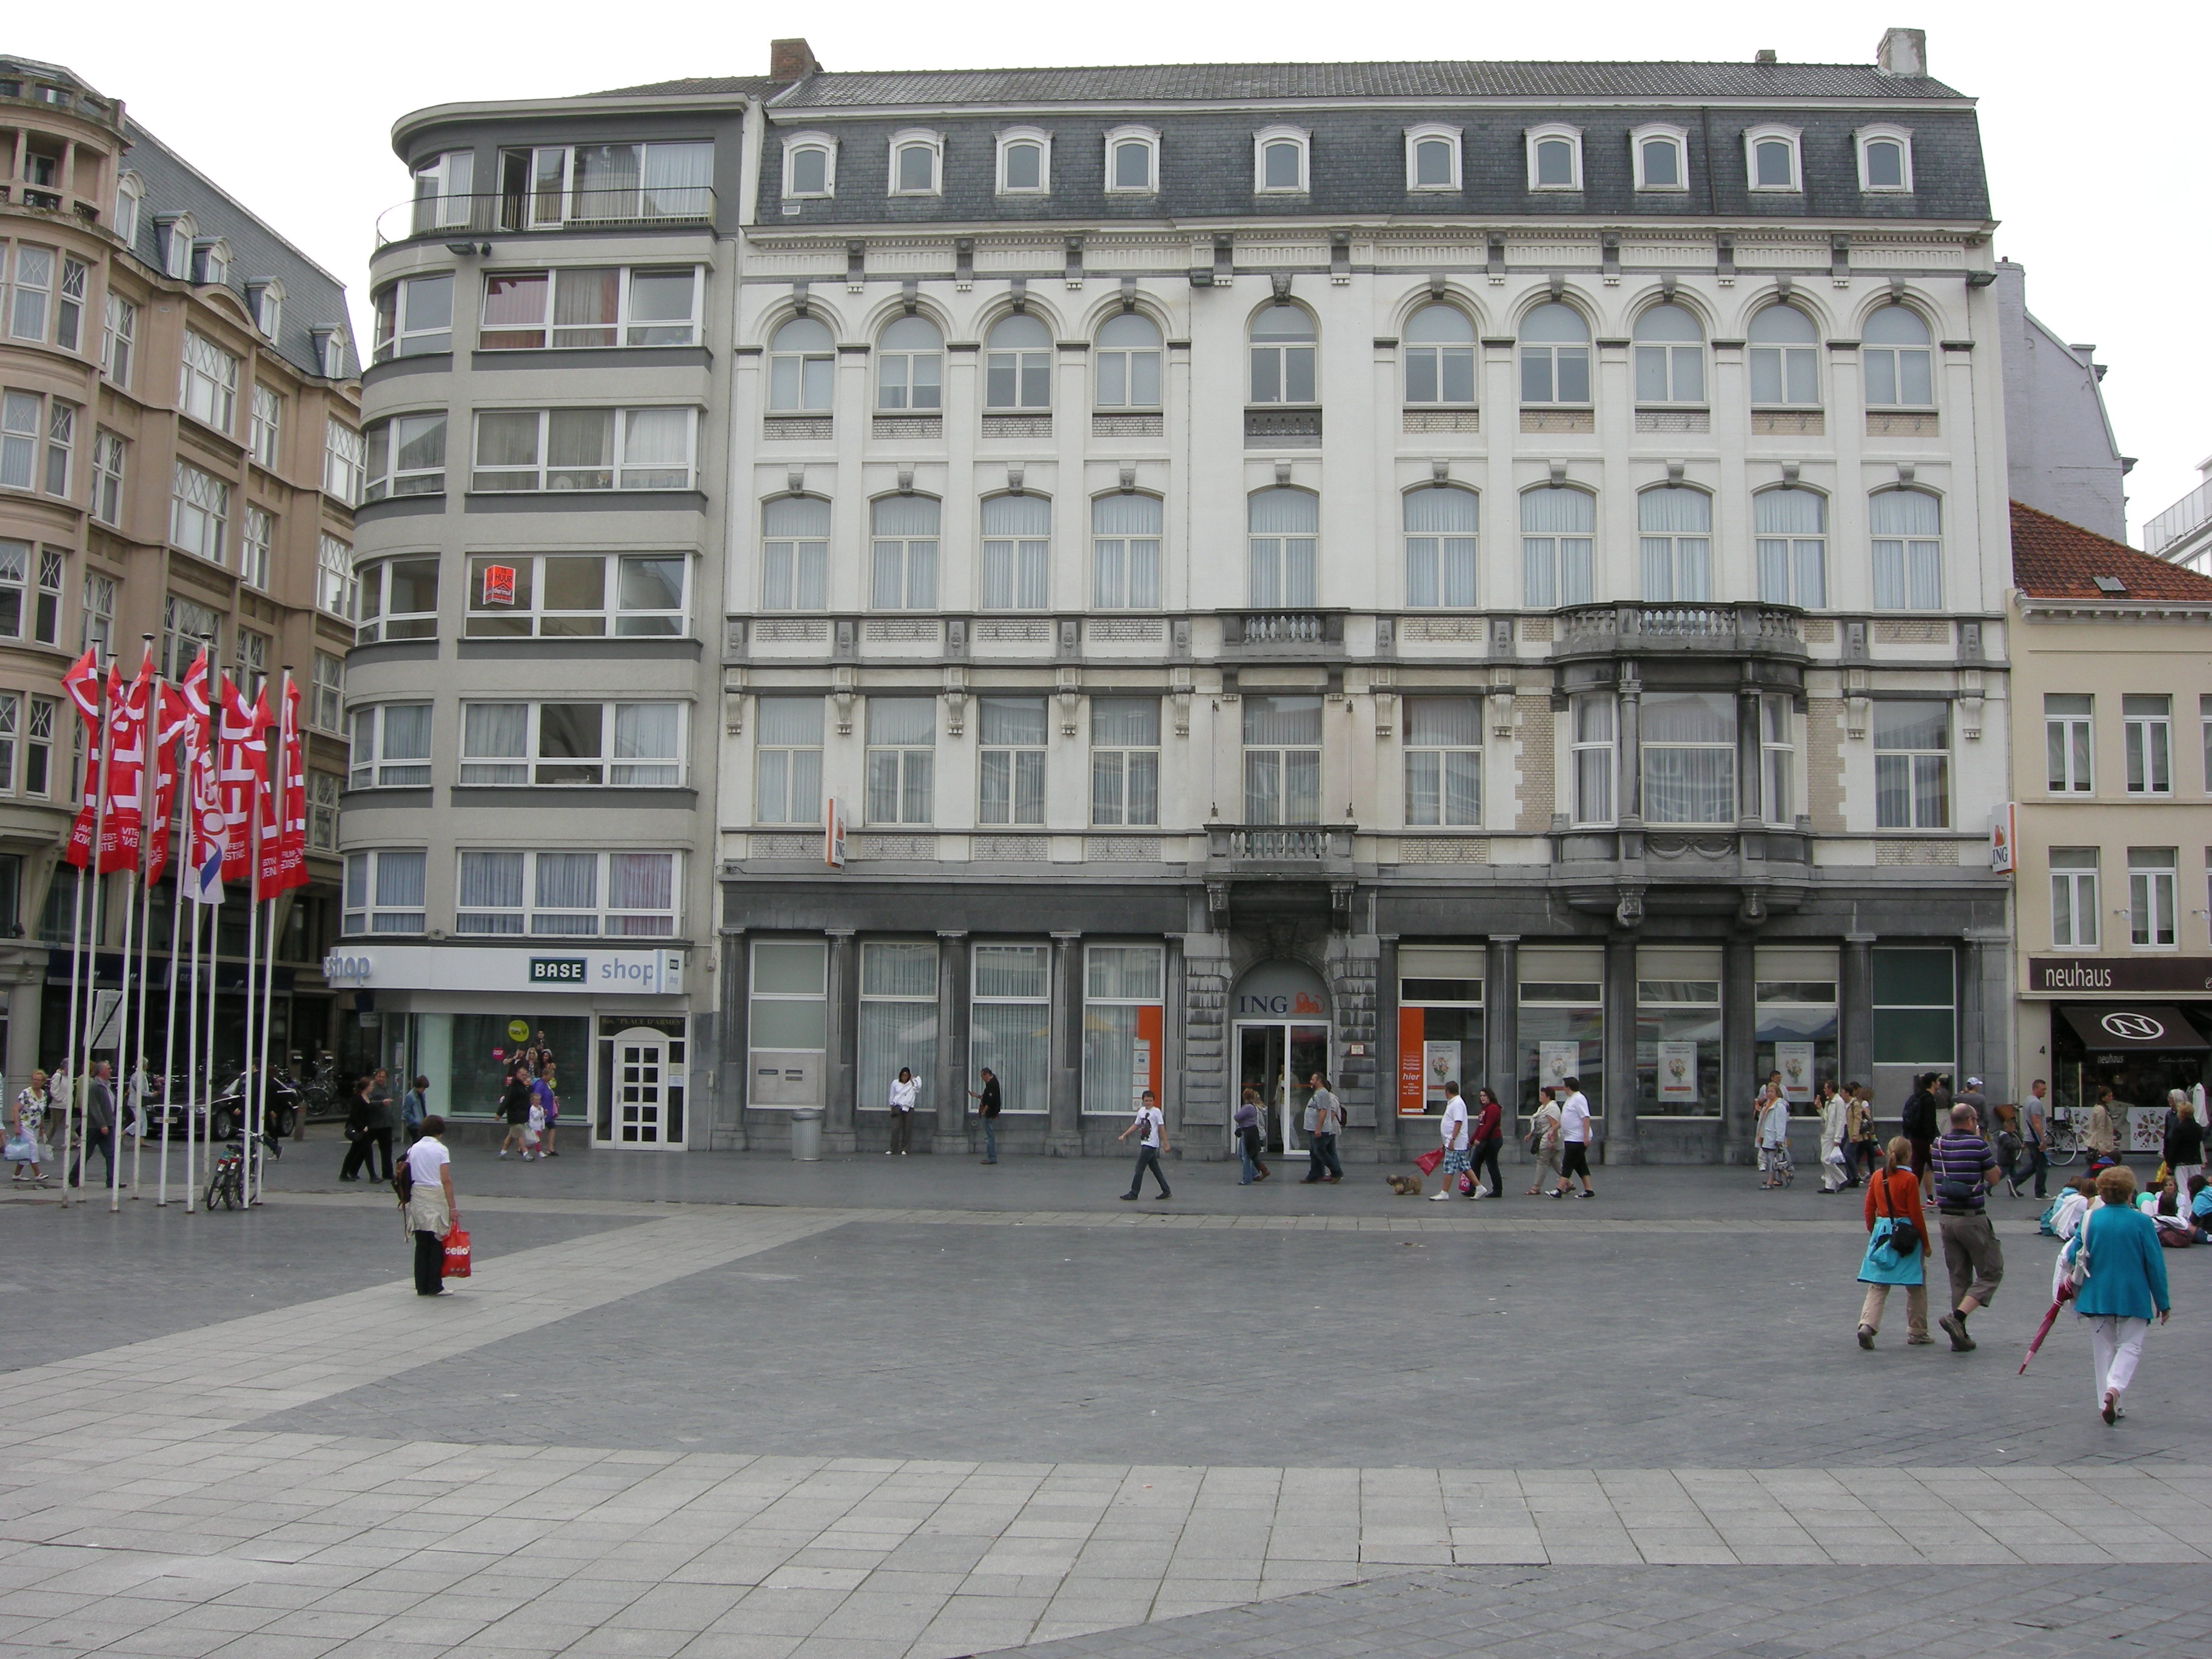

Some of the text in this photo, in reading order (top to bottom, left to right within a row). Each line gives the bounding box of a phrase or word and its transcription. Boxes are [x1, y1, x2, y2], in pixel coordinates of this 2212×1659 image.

[495, 573, 512, 583] HUUR
[835, 840, 845, 858] ING
[1992, 846, 2008, 865] ING
[329, 949, 370, 985] shop
[535, 957, 653, 985] BASE shop
[2046, 961, 2111, 987] neuhaus
[1239, 996, 1289, 1013] ING
[2110, 1018, 2156, 1034] N
[2039, 1045, 2045, 1054] 4
[2097, 1053, 2124, 1064] neuhaus
[445, 1245, 469, 1255] celio
